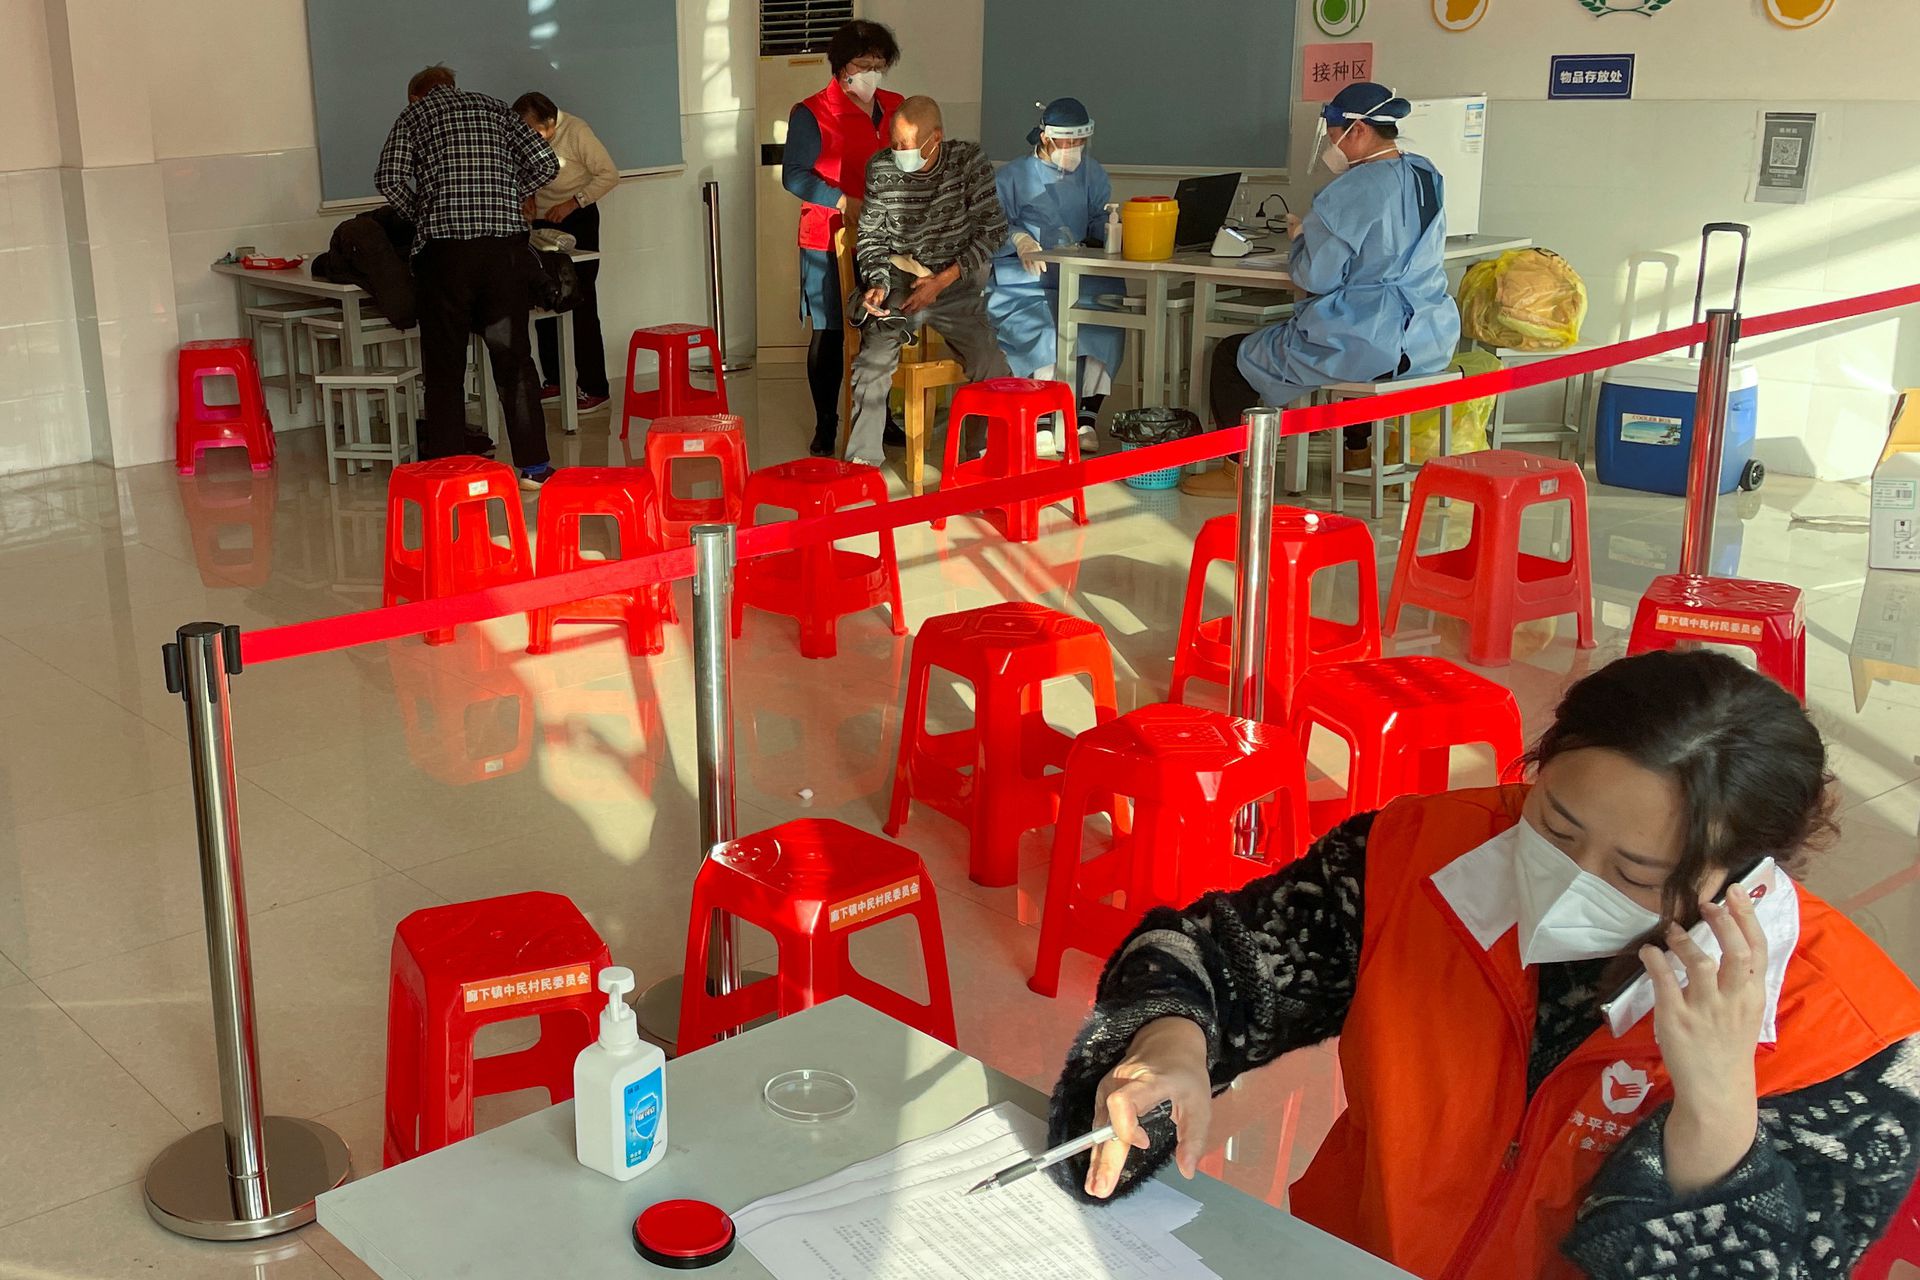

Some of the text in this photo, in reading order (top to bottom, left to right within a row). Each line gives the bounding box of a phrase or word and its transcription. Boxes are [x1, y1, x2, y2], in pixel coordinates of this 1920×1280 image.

[1312, 60, 1366, 82] 接种区
[1560, 70, 1623, 84] 物品存放处
[465, 971, 590, 1004] 廊下镇中民村民委员会
